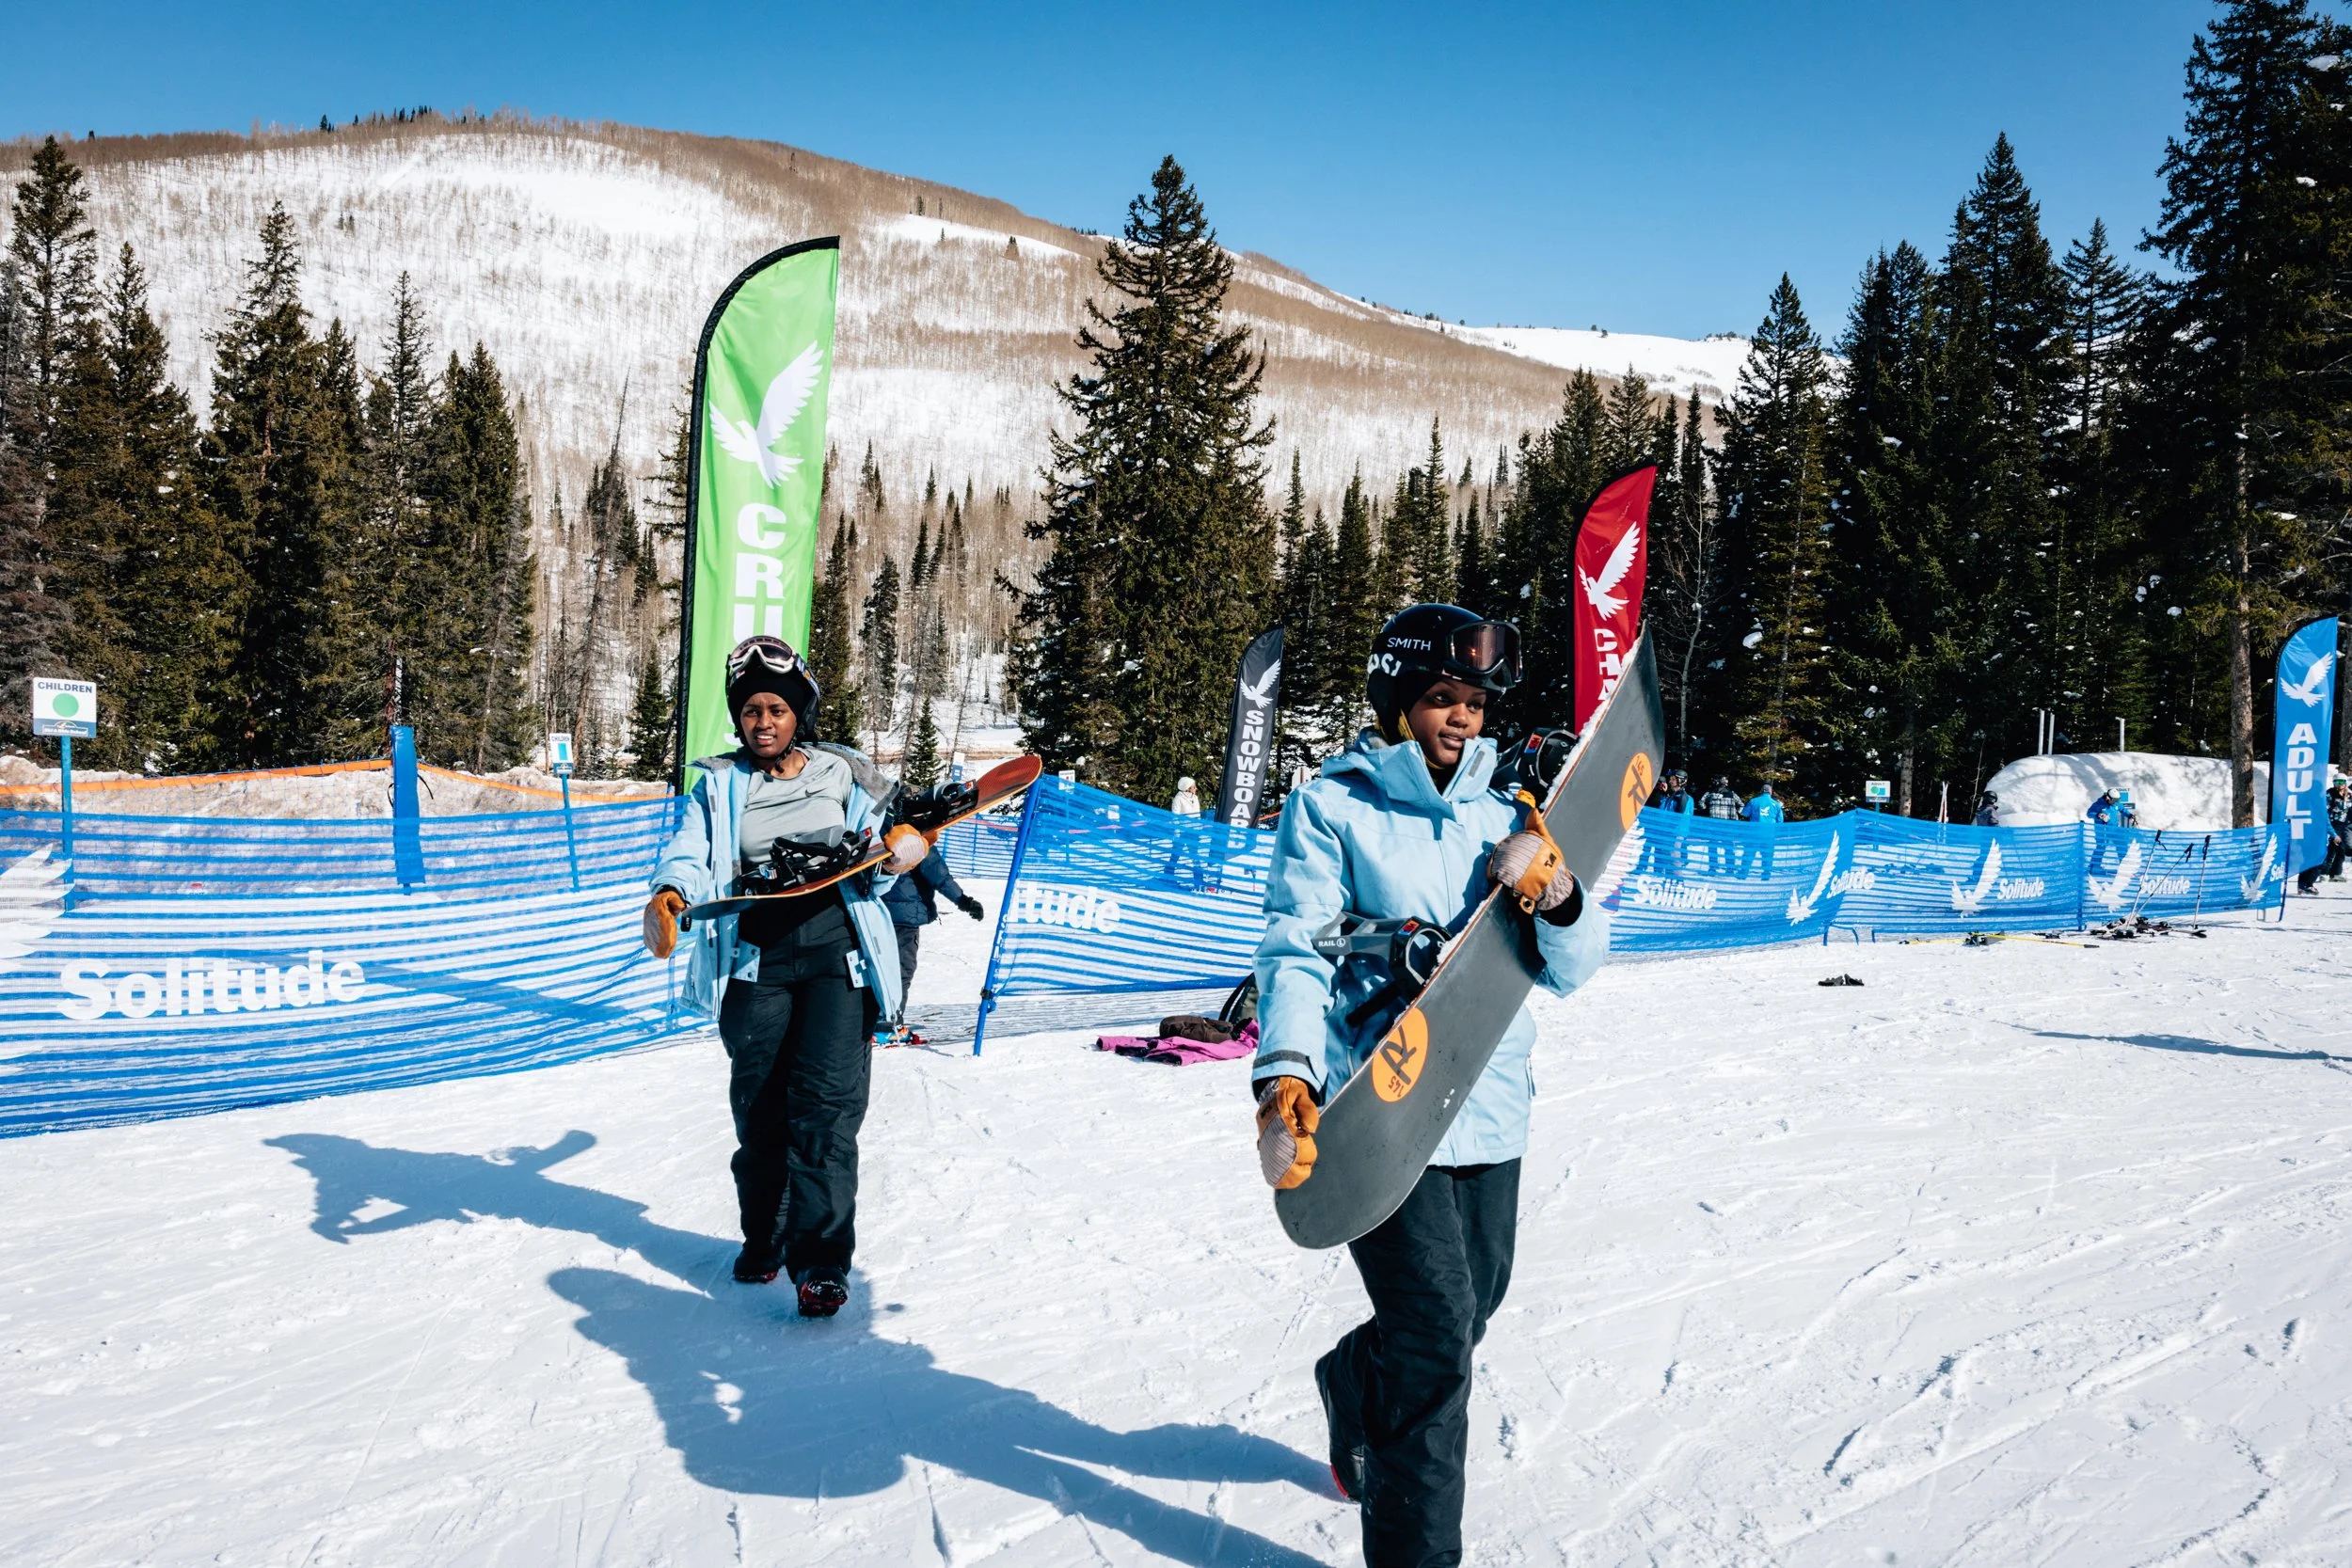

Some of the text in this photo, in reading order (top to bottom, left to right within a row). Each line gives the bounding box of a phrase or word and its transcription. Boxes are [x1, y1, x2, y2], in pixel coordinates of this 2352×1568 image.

[1387, 637, 1432, 651] SMITH
[38, 682, 92, 693] CHILDREN
[2284, 722, 2318, 840] ADULT
[1634, 876, 1717, 910] Solitude
[1996, 877, 2044, 900] Solitude
[2138, 875, 2191, 895] Solitude
[56, 950, 366, 1021] Solitude
[1389, 1075, 1405, 1098] 145
